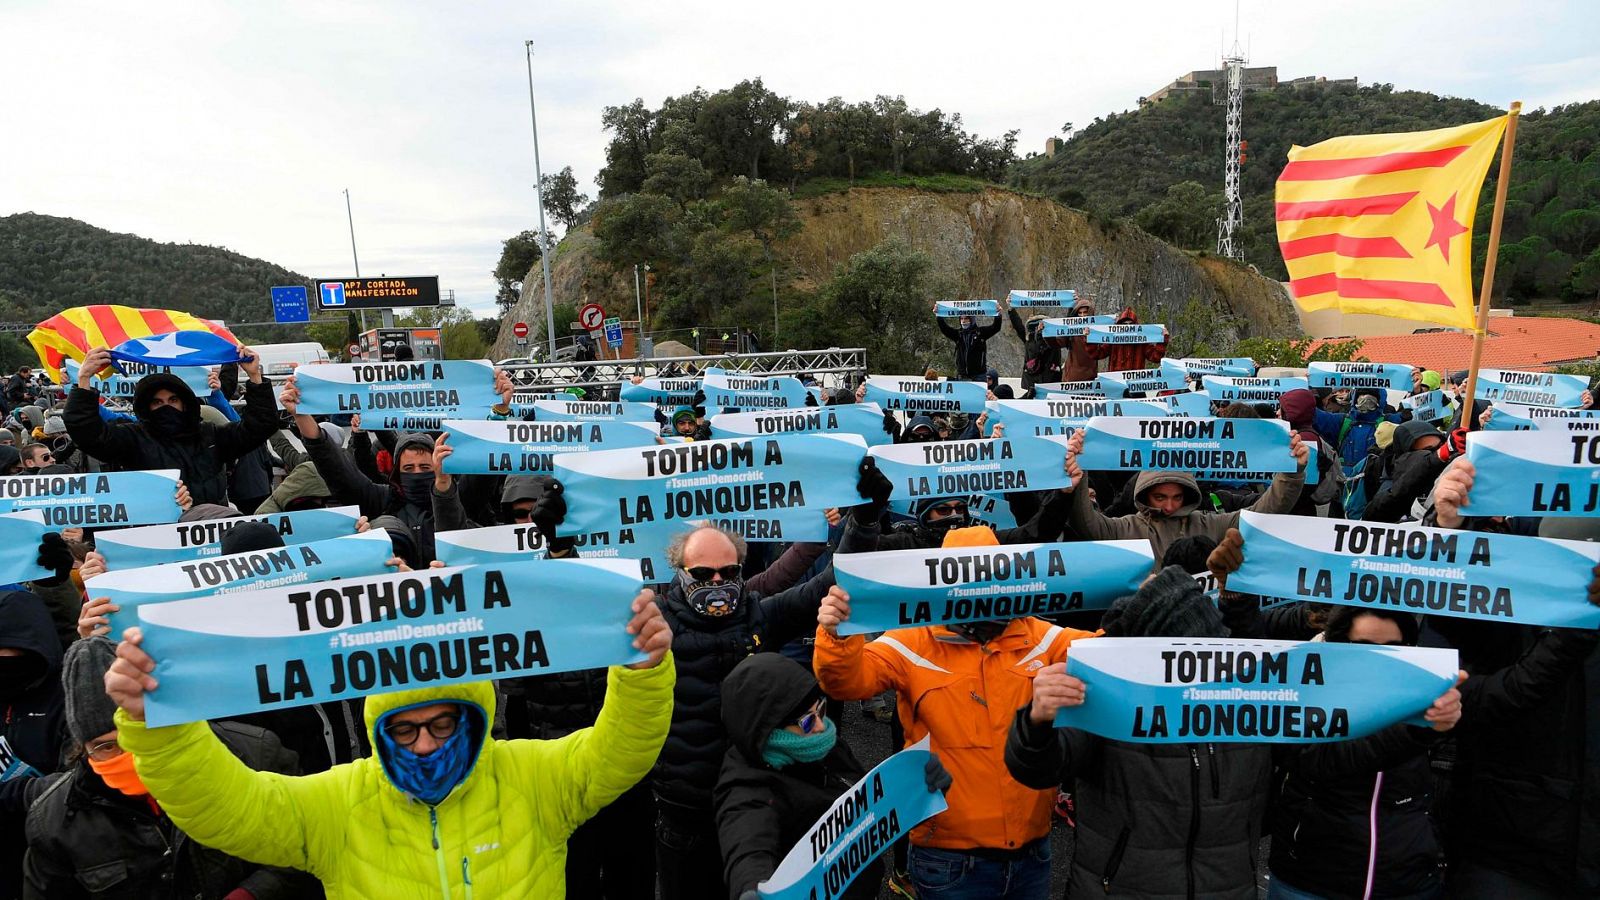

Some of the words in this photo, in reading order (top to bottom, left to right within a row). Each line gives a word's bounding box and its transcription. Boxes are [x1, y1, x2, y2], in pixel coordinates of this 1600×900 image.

[345, 281, 361, 289] AP7
[367, 280, 406, 288] CORTADA
[345, 288, 418, 297] MANIFESTACION
[352, 364, 426, 382] TOTHOM
[432, 363, 444, 380] A
[1122, 371, 1153, 380] TOTHOM
[1335, 364, 1373, 373] TOTHOM
[1377, 364, 1384, 373] A
[660, 380, 698, 390] TOTHOM
[727, 378, 768, 391] TOTHOM
[772, 380, 779, 390] A
[898, 381, 942, 394] TOTHOM
[946, 382, 953, 394] A
[1060, 383, 1093, 391] TOTHOM
[1324, 377, 1336, 387] LA
[1340, 377, 1390, 388] JONQUERA
[1500, 372, 1543, 386] TOTHOM
[1545, 376, 1553, 386] A
[338, 393, 361, 411] LA
[368, 390, 460, 410] JONQUERA
[717, 395, 729, 406] LA
[734, 395, 788, 408] JONQUERA
[1222, 390, 1233, 399] LA
[1485, 388, 1498, 400] LA
[1501, 389, 1557, 405] JONQUERA
[566, 403, 612, 415] TOTHOM
[616, 404, 624, 415] A
[887, 398, 900, 409] LA
[904, 399, 961, 411] JONQUERA
[1048, 402, 1107, 417] TOTHOM
[1113, 403, 1123, 416] A
[384, 417, 398, 429] LA
[755, 414, 820, 434] TOTHOM
[827, 413, 838, 429] A
[1139, 420, 1214, 438] TOTHOM
[1221, 421, 1234, 439] A
[507, 425, 578, 442] TOTHOM
[590, 425, 603, 442] A
[488, 453, 512, 471] LA
[642, 442, 754, 477] TOTHOM
[764, 440, 783, 467] A
[923, 442, 994, 464] TOTHOM
[1001, 441, 1013, 459] A
[1120, 449, 1142, 467] LA
[1149, 450, 1248, 469] JONQUERA
[95, 476, 110, 494] A
[666, 471, 764, 489] #TsunamiDemocràtic
[908, 476, 930, 496] LA
[937, 470, 1028, 494] JONQUERA
[619, 496, 654, 525] LA
[664, 481, 805, 520] JONQUERA
[1532, 483, 1571, 512] LA
[279, 516, 293, 536] A
[1334, 525, 1458, 563] TOTHOM
[1468, 537, 1490, 567] A
[182, 552, 295, 588] TOTHOM
[299, 546, 322, 567] A
[925, 550, 1036, 586] TOTHOM
[1048, 550, 1066, 577] A
[1351, 559, 1466, 580] #TsunamiDemocràtic
[947, 582, 1046, 598] #TsunamiDemocràtic
[1297, 568, 1332, 599] LA
[1344, 572, 1514, 618] JONQUERA
[289, 573, 469, 631] TOTHOM
[483, 570, 511, 610] A
[899, 602, 932, 625] LA
[942, 592, 1084, 621] JONQUERA
[329, 617, 484, 649] #TsunamiDemocràtic
[256, 658, 313, 704] LA
[329, 630, 550, 695] JONQUERA
[1161, 651, 1288, 684] TOTHOM
[1301, 653, 1325, 686] A
[1182, 687, 1298, 702] #TsunamiDemocràtic
[1132, 706, 1169, 738] LA
[1178, 704, 1350, 738] JONQUERA
[810, 782, 869, 863] TOTHOM
[873, 772, 884, 803] A
[822, 808, 901, 900] JONQUERA
